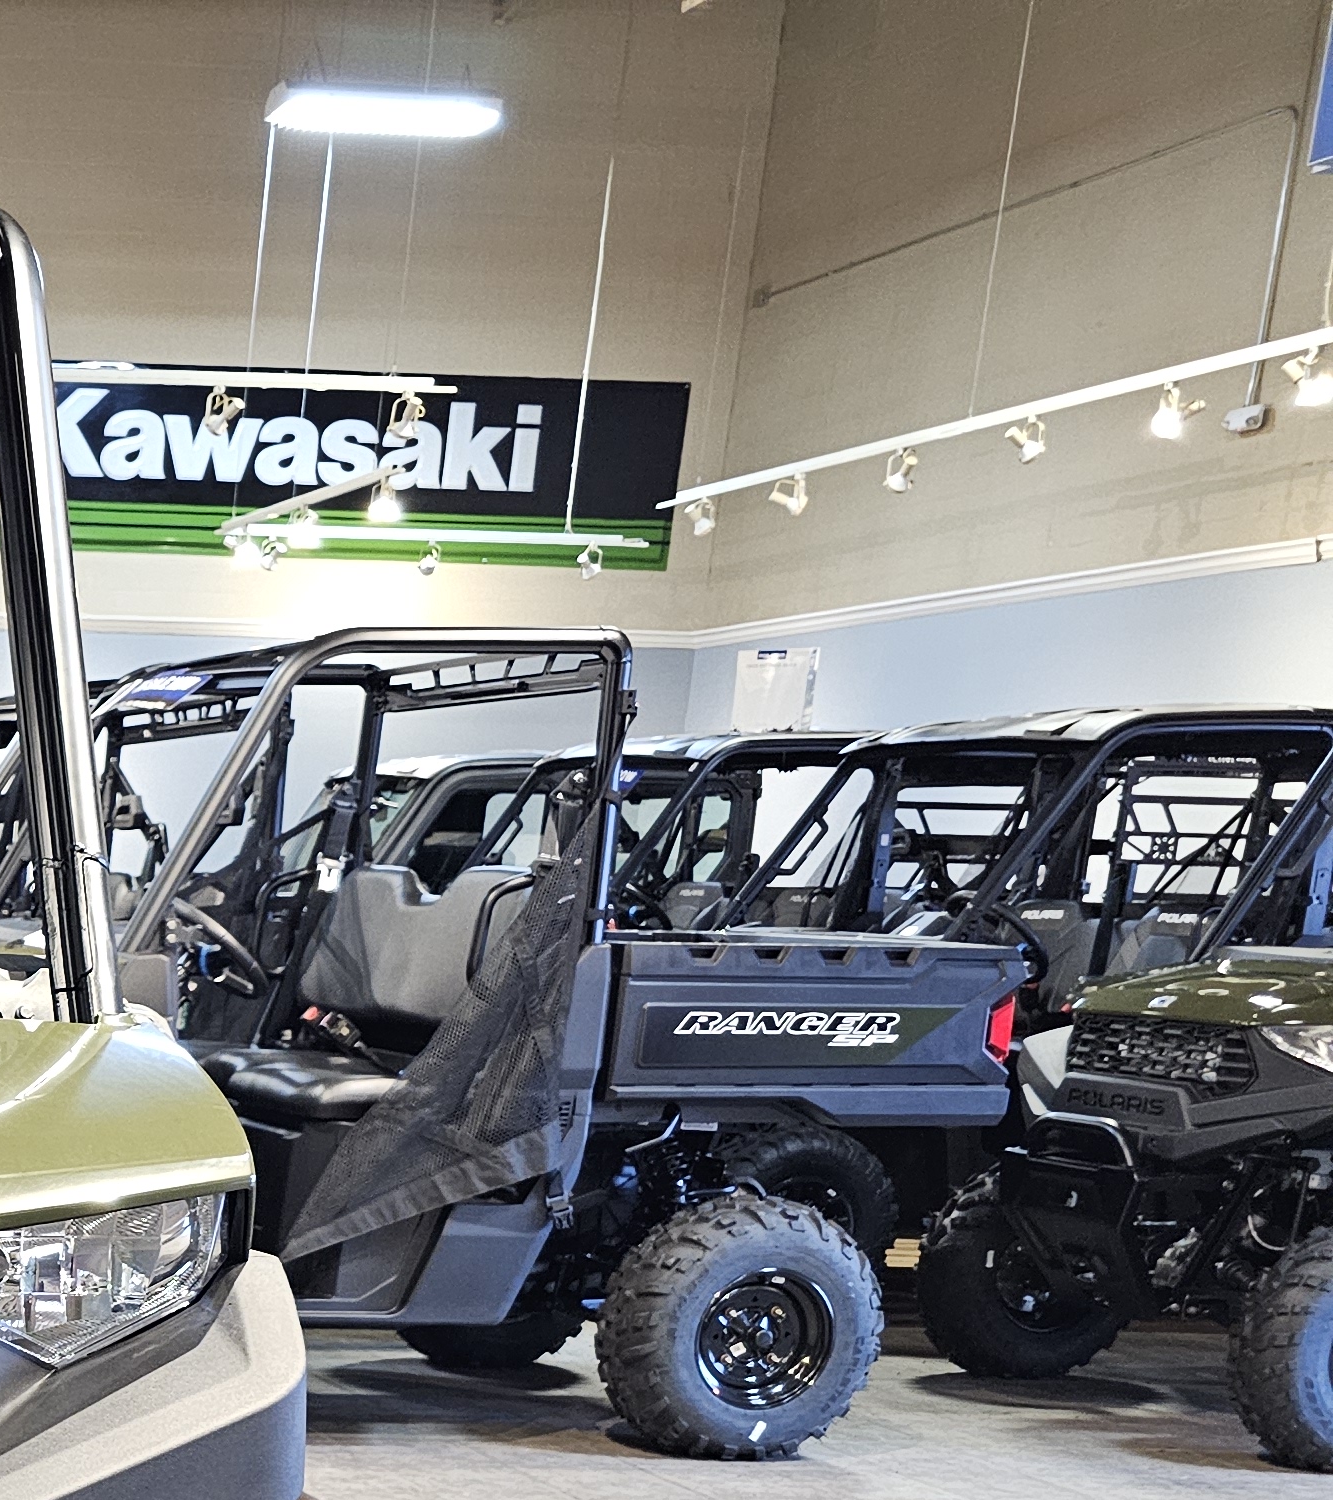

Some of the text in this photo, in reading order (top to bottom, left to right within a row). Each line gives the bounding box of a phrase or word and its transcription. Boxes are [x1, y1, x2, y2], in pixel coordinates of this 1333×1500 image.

[56, 386, 543, 493] Kawasaki
[673, 1011, 901, 1036] RANGER
[827, 1033, 900, 1047] SP
[1067, 1087, 1166, 1117] POLARIS
